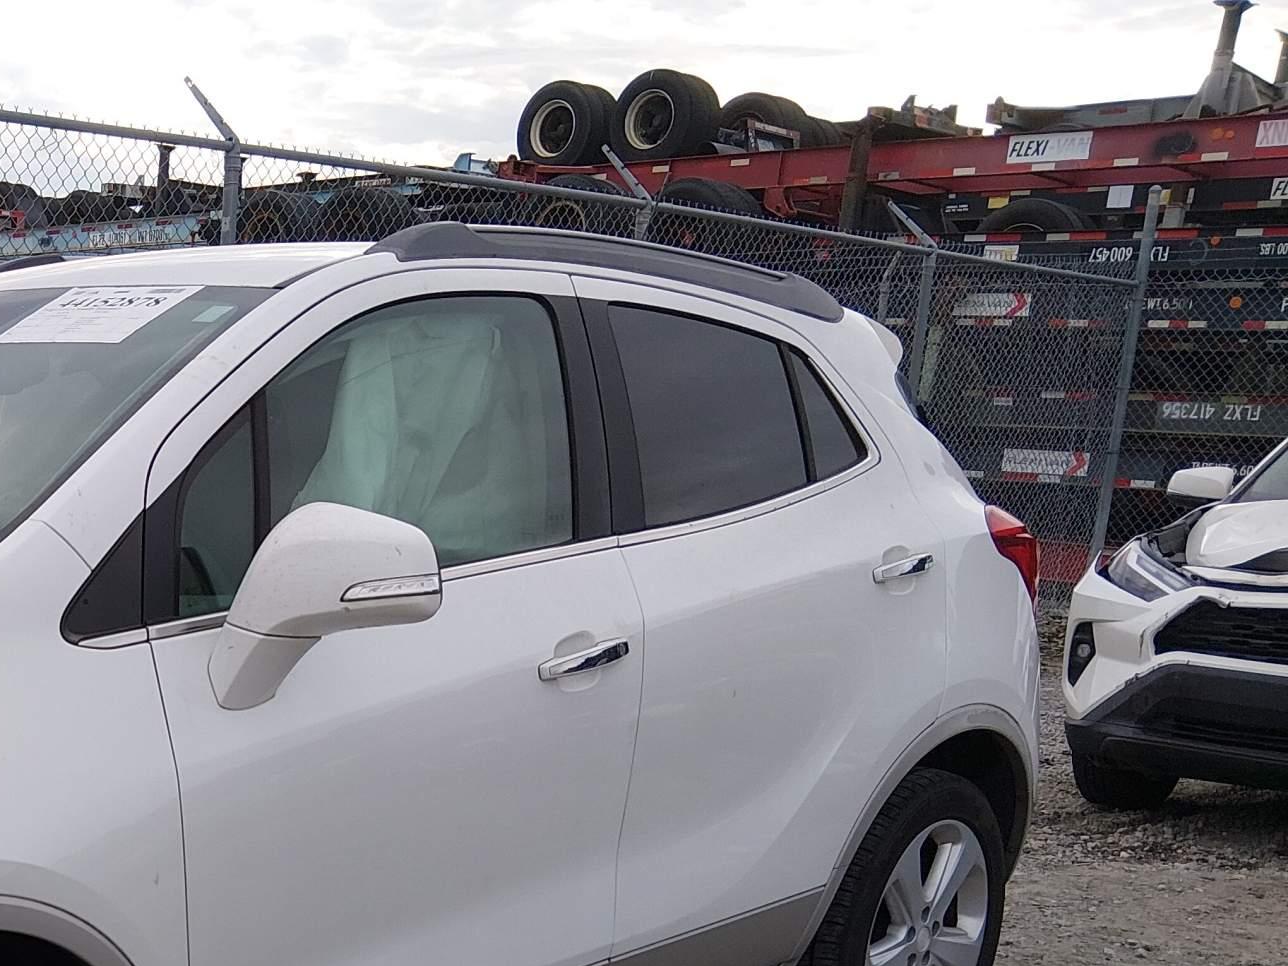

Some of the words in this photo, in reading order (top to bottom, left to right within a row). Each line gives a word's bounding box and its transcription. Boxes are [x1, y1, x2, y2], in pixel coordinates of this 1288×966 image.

[1088, 246, 1133, 263] 600457
[59, 295, 169, 308] 44152878
[1162, 402, 1215, 419] 417356
[1223, 404, 1261, 421] FLXZ
